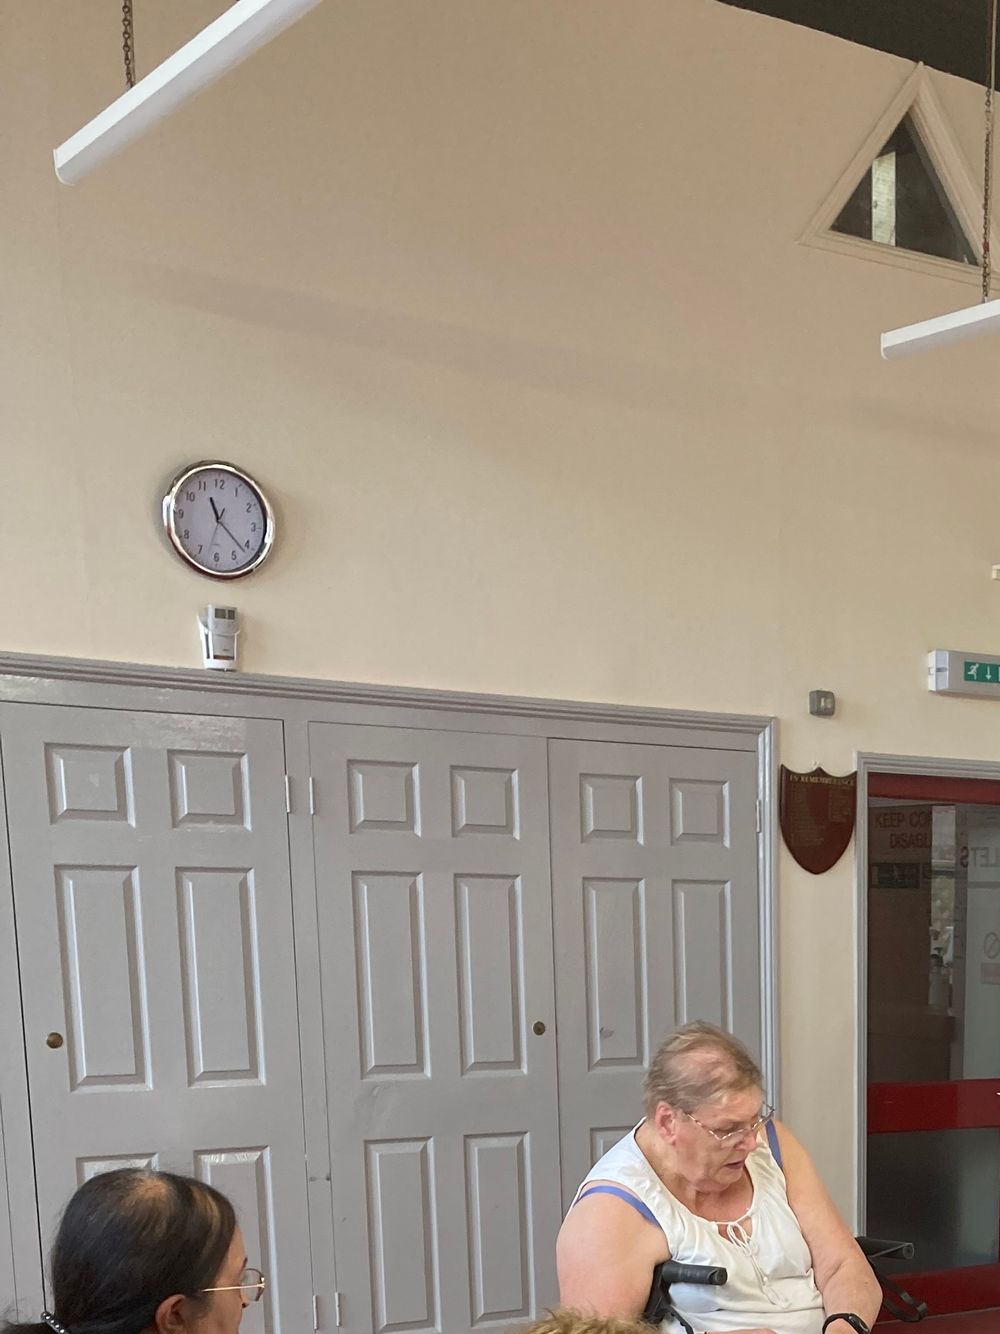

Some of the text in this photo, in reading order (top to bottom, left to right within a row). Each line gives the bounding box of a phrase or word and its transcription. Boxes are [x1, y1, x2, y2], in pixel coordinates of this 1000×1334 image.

[214, 479, 225, 489] 12
[186, 491, 195, 502] 10
[246, 502, 252, 513] 2
[178, 509, 184, 519] 9
[250, 522, 257, 533] 3
[183, 529, 190, 539] 8
[198, 544, 203, 554] 7
[244, 539, 250, 549] 4
[213, 552, 220, 562] 6
[231, 550, 237, 560] 5
